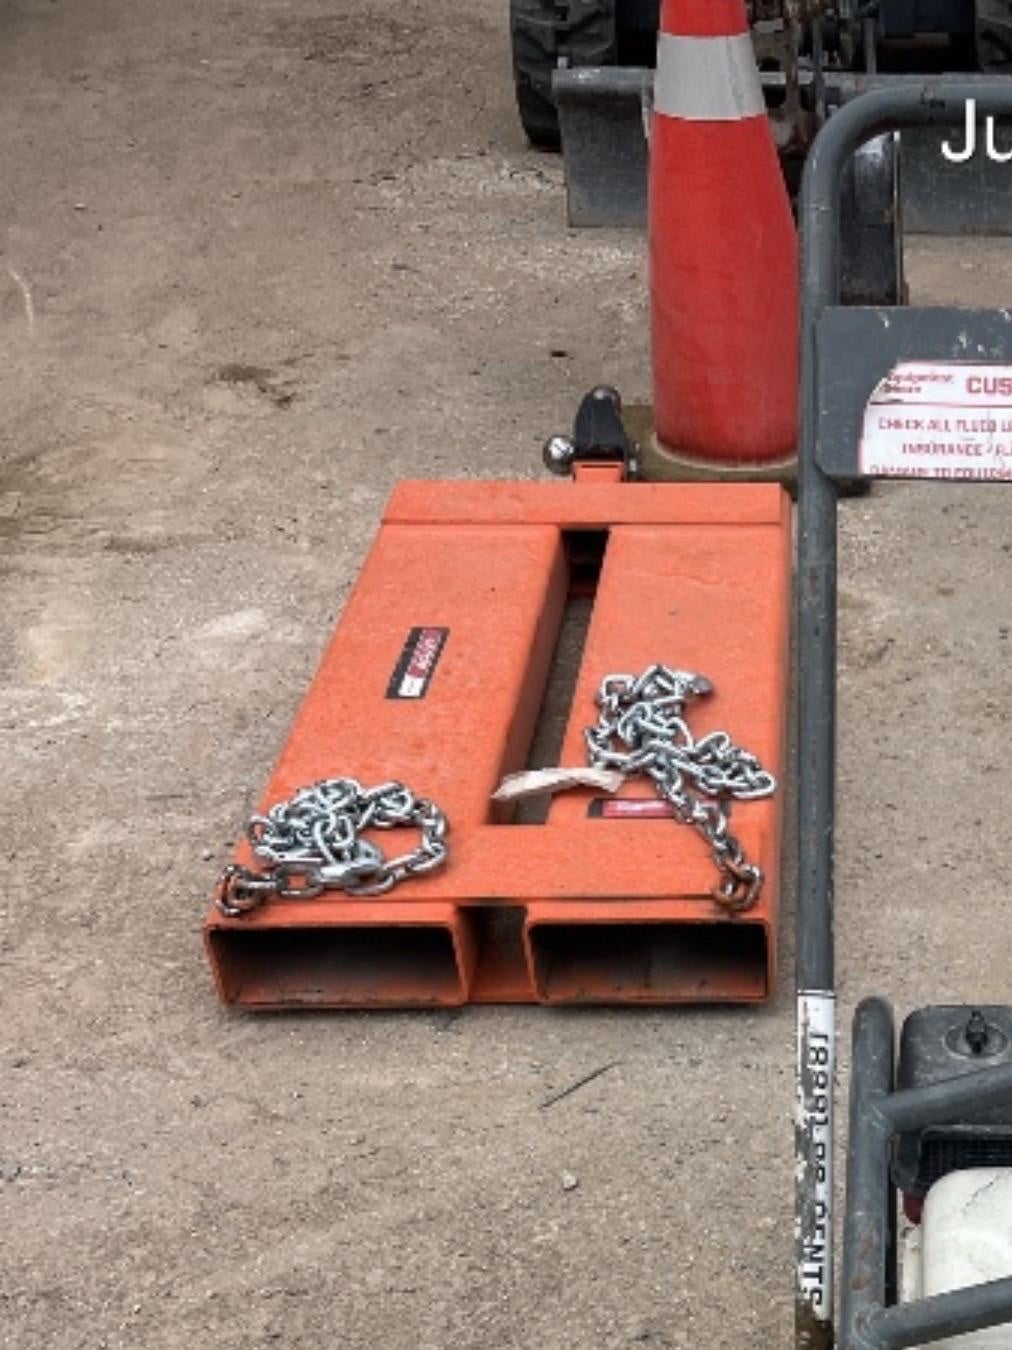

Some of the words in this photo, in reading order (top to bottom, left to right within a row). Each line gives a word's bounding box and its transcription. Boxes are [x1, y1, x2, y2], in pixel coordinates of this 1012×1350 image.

[877, 417, 924, 431] CHECK
[927, 418, 952, 433] ALL
[956, 418, 997, 433] FLUID
